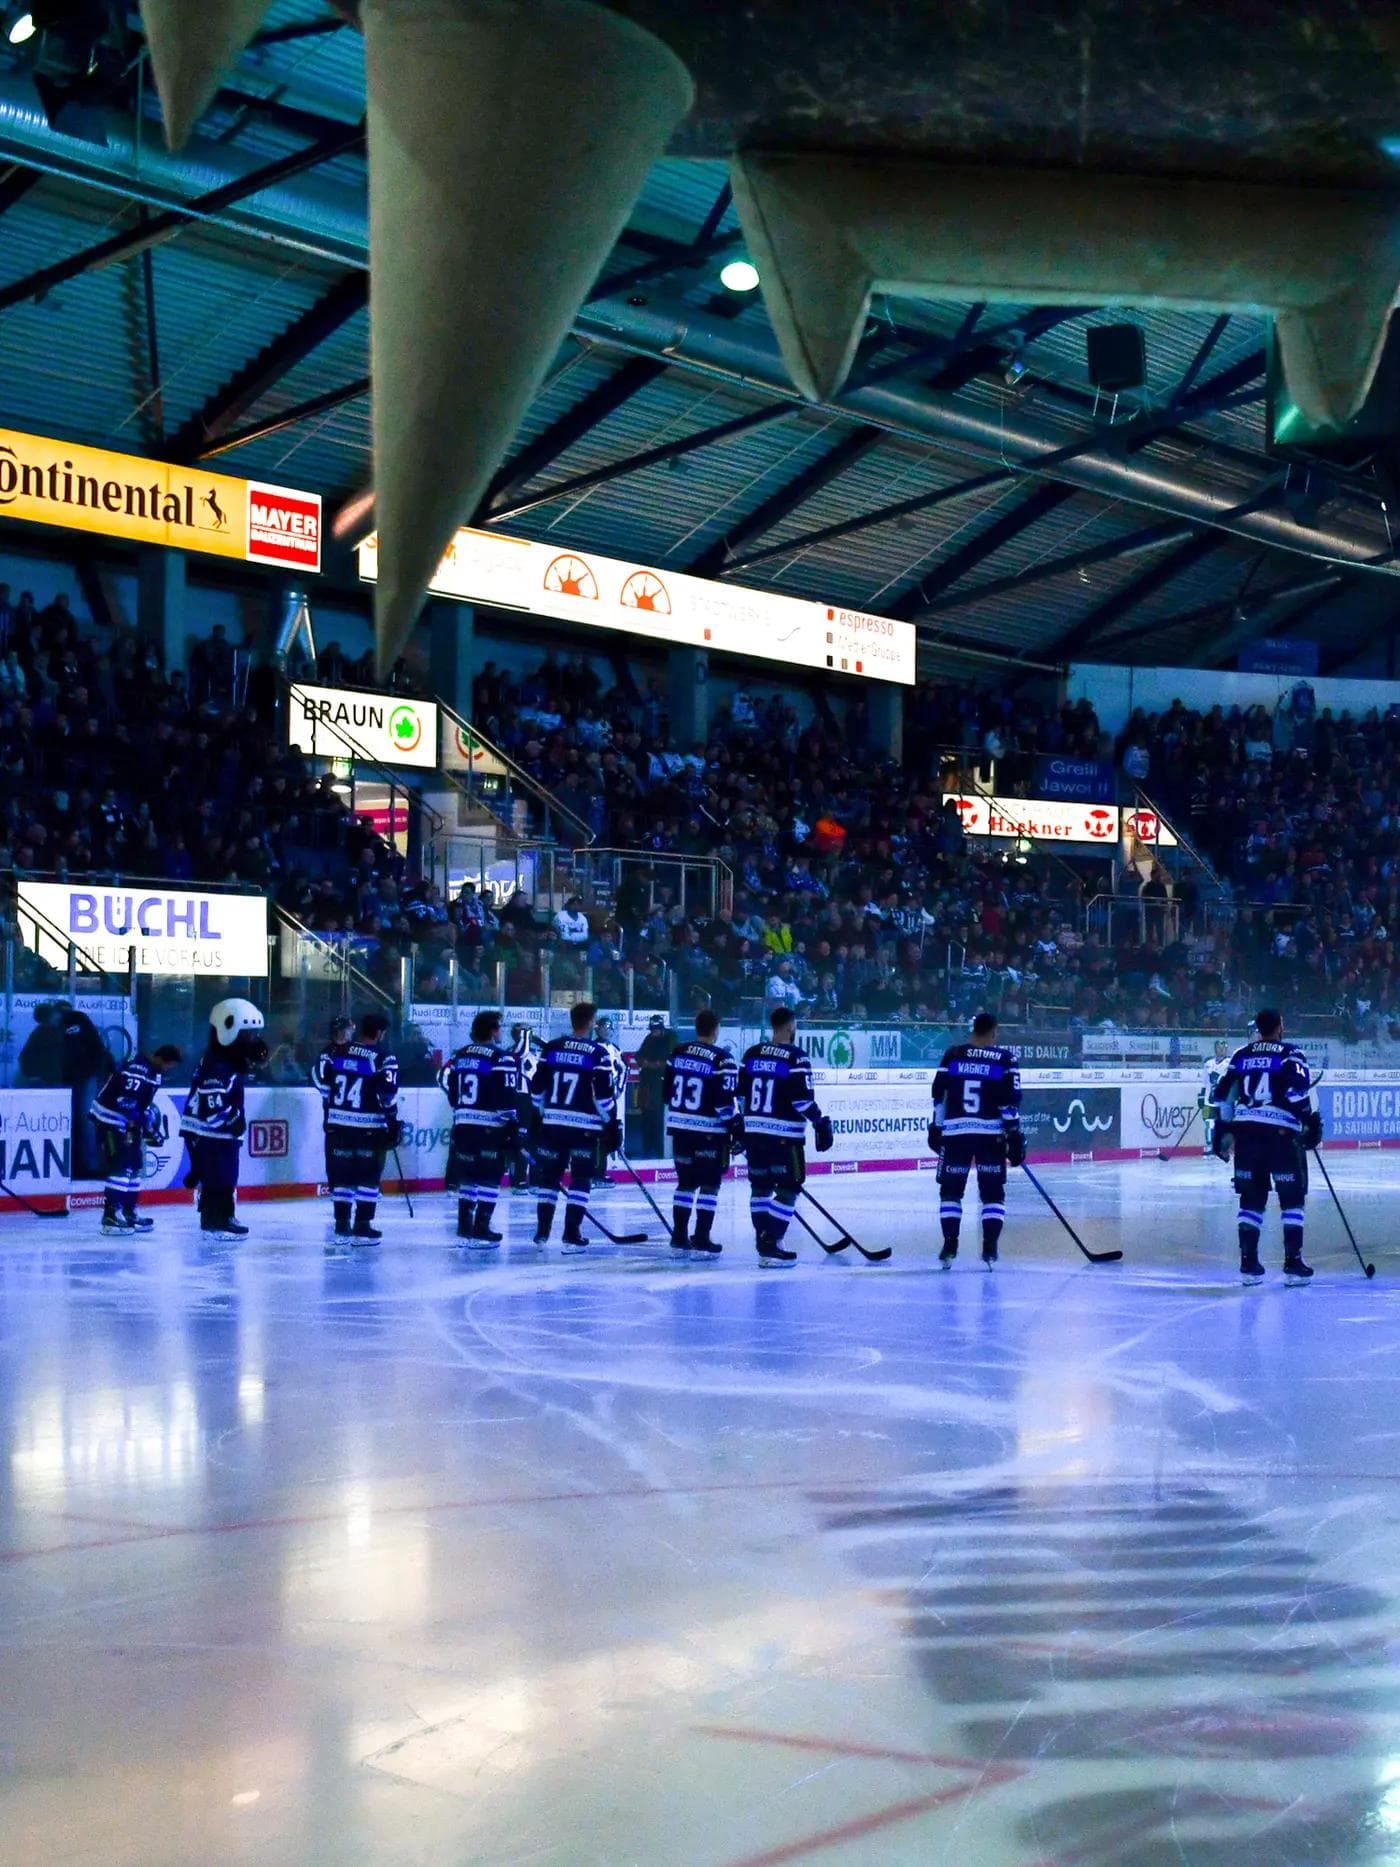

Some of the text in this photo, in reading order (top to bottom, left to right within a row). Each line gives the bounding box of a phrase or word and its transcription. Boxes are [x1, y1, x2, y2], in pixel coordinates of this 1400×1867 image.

[0, 446, 195, 527] ontinental
[250, 503, 318, 537] MAYER
[839, 611, 894, 637] espresso
[303, 698, 384, 729] BRAUN
[69, 893, 222, 940] BÜCHL
[113, 947, 148, 967] IDE
[466, 1045, 494, 1057] SATURN
[564, 1040, 595, 1054] SATURN
[687, 1045, 717, 1060] SATURN
[760, 1045, 790, 1060] SATURN
[967, 1048, 1002, 1060] SATURN
[1036, 1046, 1070, 1059] DAILY?
[1251, 1041, 1284, 1053] SATURN
[958, 1063, 990, 1076] WAGNER
[125, 1078, 141, 1091] 37
[458, 1073, 479, 1105] 13
[504, 1073, 516, 1088] 13
[551, 1072, 579, 1105] 17
[207, 1094, 223, 1108] 64
[334, 1075, 363, 1108] 34
[671, 1075, 703, 1110] 33
[751, 1077, 775, 1113] 61
[963, 1080, 982, 1113] 5
[833, 1116, 931, 1136] REUNDSCHAFTSC
[1345, 1121, 1380, 1135] SATURN
[253, 1125, 284, 1152] DB
